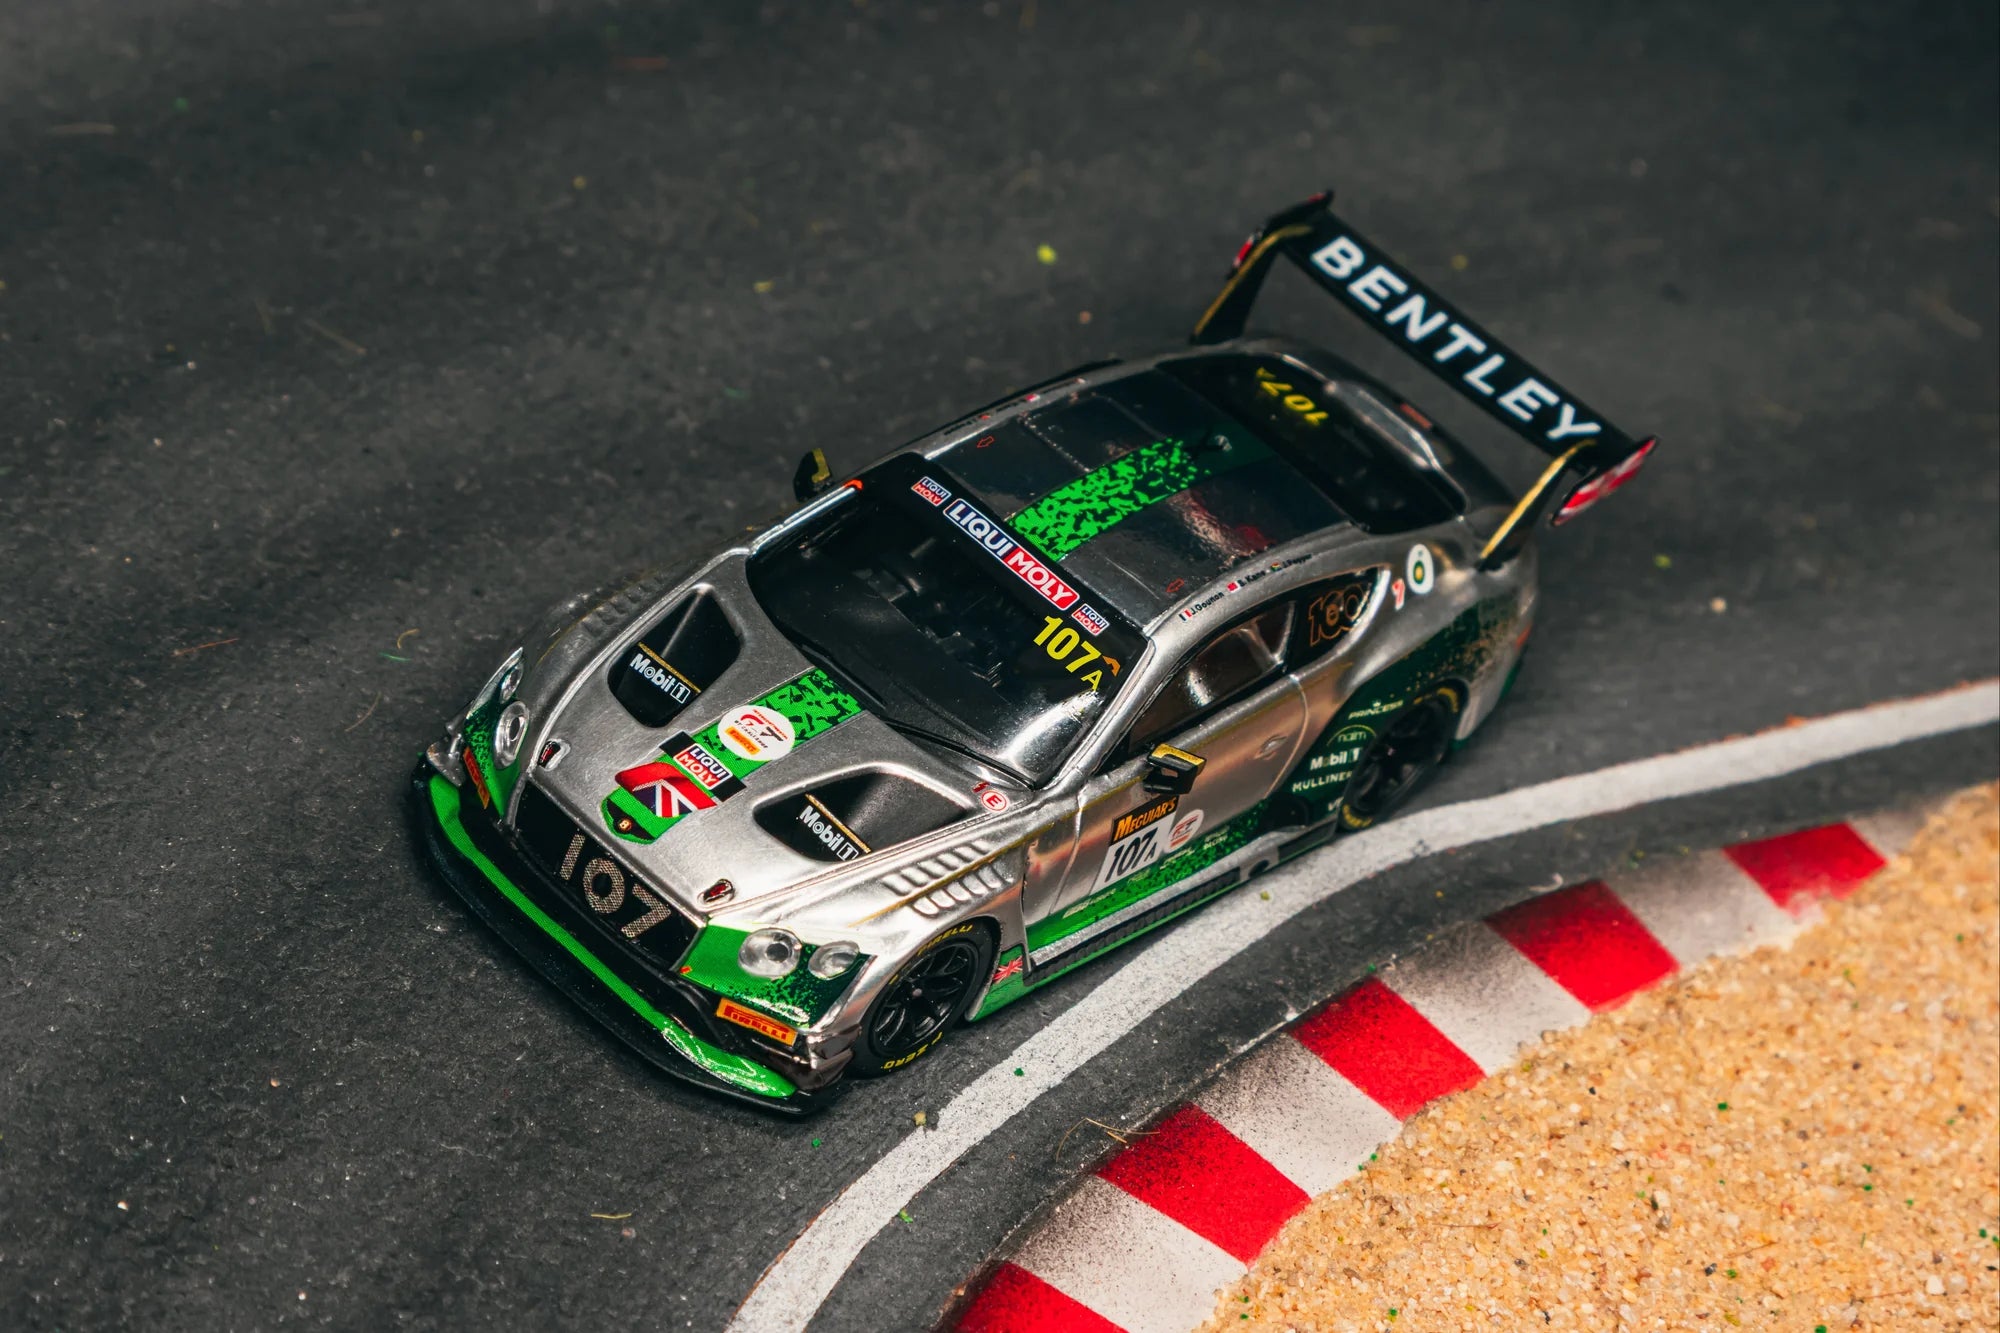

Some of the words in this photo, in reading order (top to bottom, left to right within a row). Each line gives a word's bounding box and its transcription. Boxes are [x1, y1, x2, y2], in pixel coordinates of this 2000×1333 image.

[1310, 236, 1601, 440] BENTLEY
[914, 484, 941, 503] MOLY
[921, 479, 947, 498] LIQUI
[949, 503, 1014, 557] LIQUI
[1007, 551, 1073, 602] MOLY
[1074, 611, 1101, 634] MOLY
[1081, 606, 1106, 628] LIQUI
[629, 653, 676, 693] Mobil
[678, 753, 717, 784] MOLY
[689, 747, 727, 779] LIQUI
[800, 805, 845, 852] Mobil
[560, 833, 672, 938] 107
[722, 1004, 790, 1041] PIRELLI
